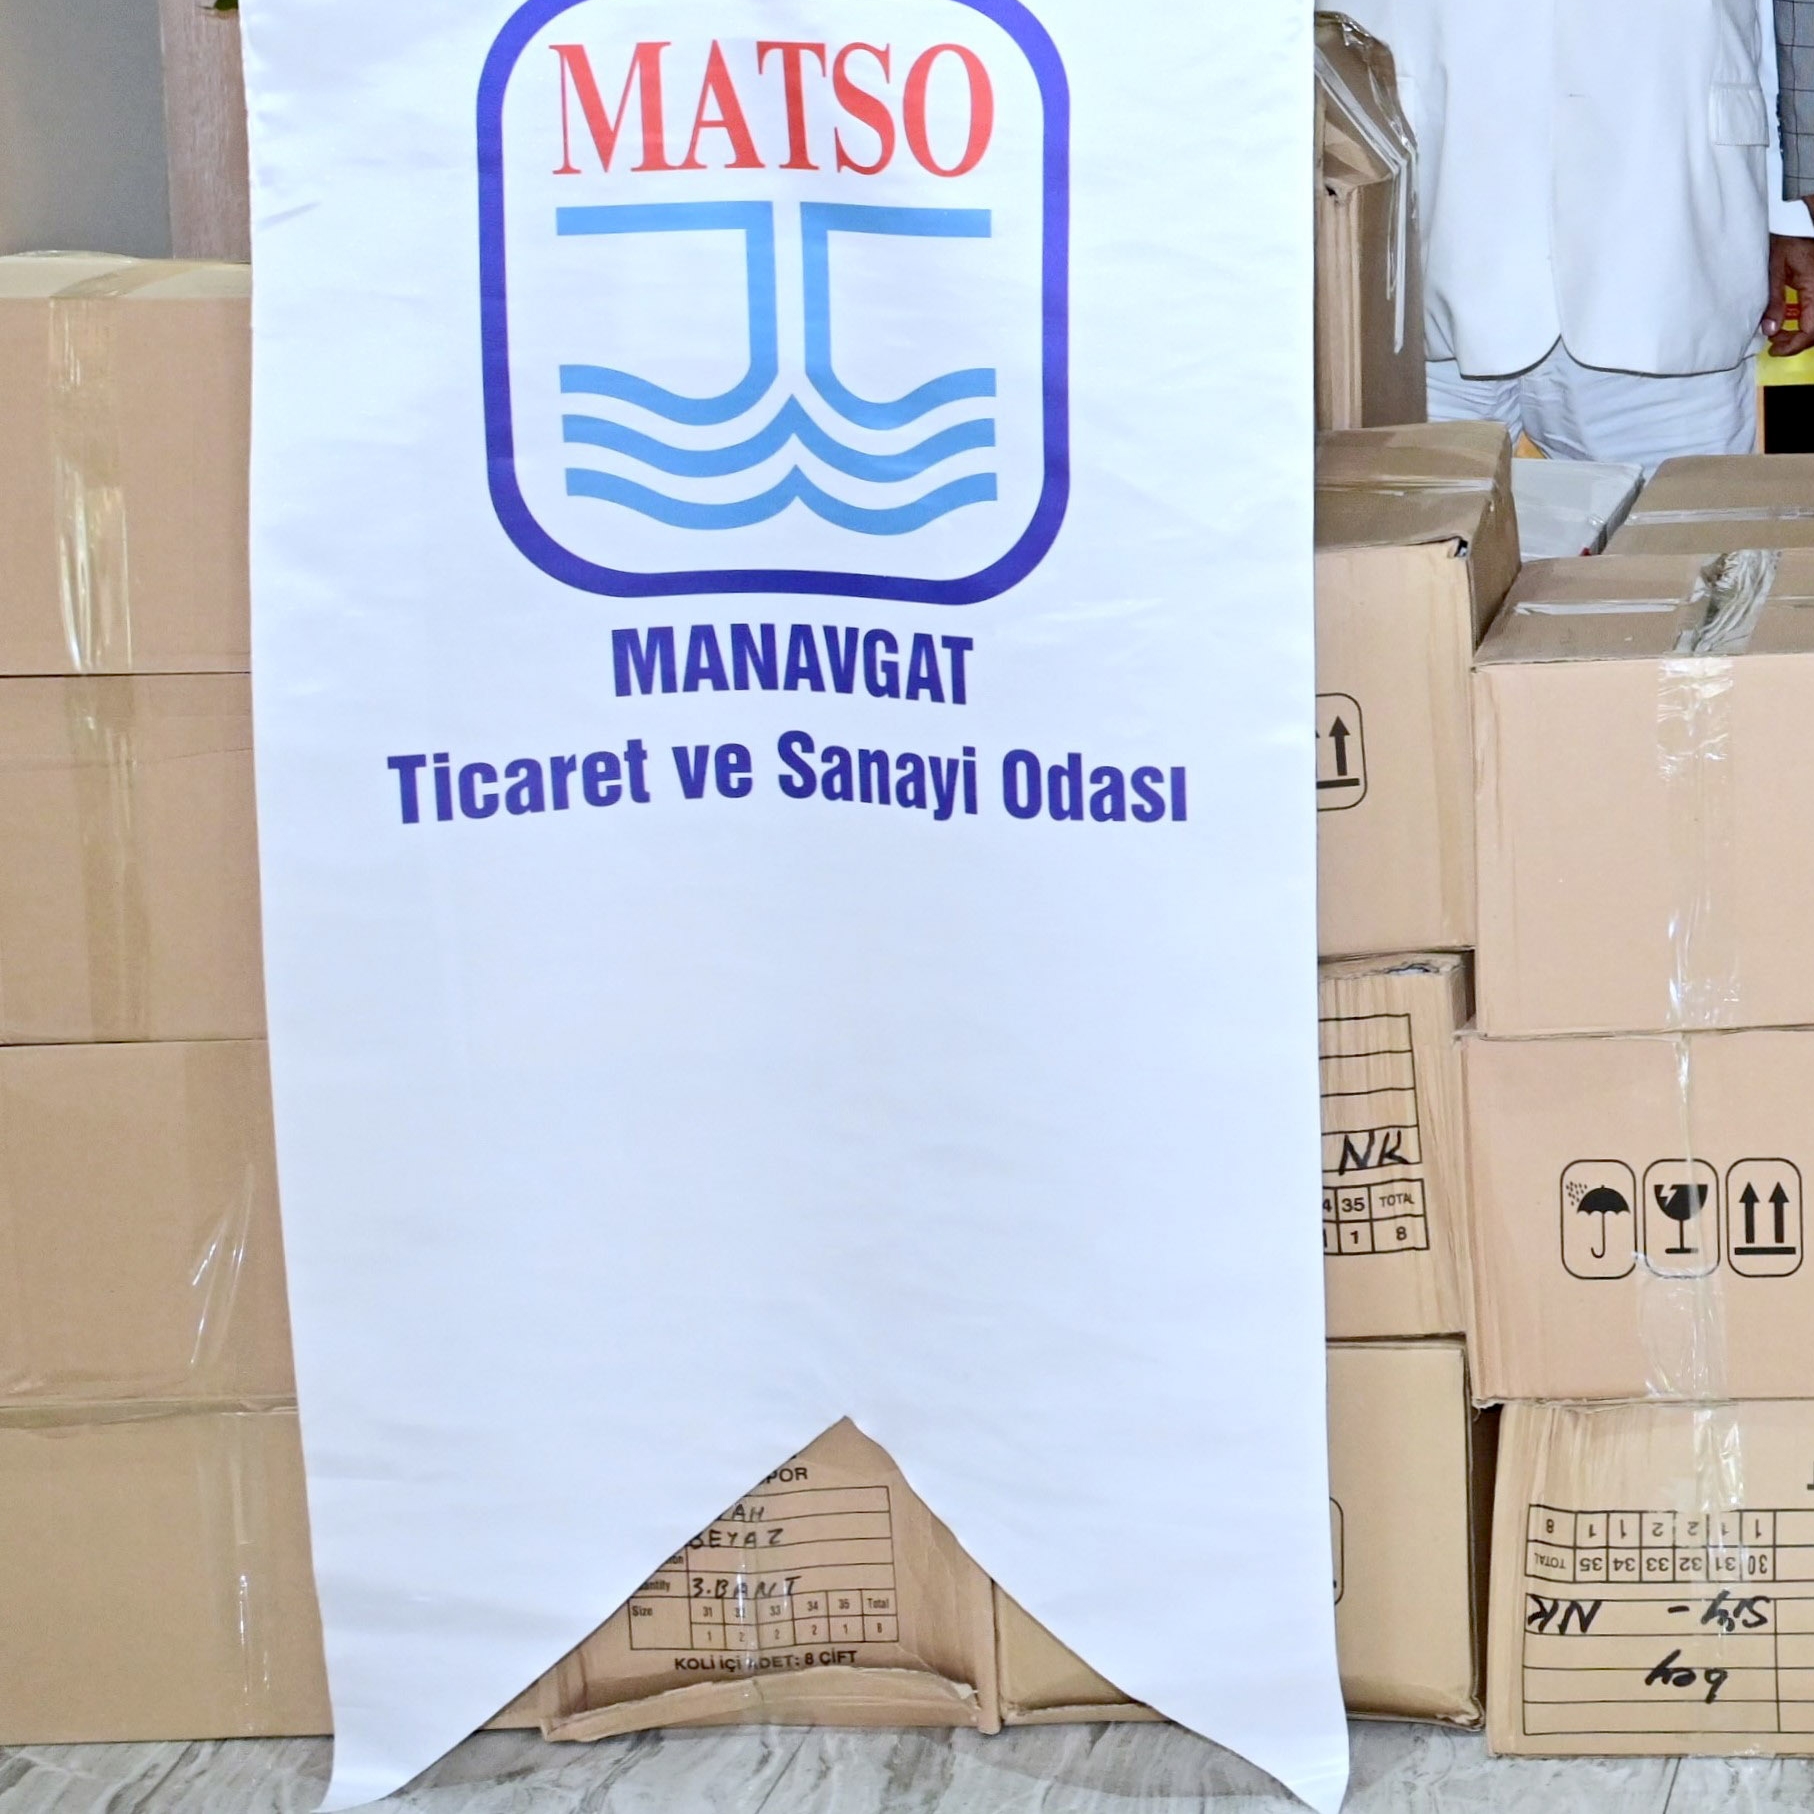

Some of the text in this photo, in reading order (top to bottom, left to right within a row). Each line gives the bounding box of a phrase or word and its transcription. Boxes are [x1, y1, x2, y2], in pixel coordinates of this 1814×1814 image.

[548, 39, 995, 179] MATSO
[611, 622, 975, 706] MANAVGAT
[387, 729, 1189, 826] Ticaret ve Sanayi Odası
[1341, 1197, 1365, 1212] 35
[1379, 1192, 1415, 1208] TOTAL
[1351, 1226, 1407, 1244] 1 8
[1545, 1518, 1763, 1539] 1 2 2 1 1 8
[1534, 1552, 1565, 1569] TOTAL
[1579, 1557, 1603, 1573] 35
[1613, 1557, 1635, 1572] 34
[1646, 1557, 1669, 1572] 33
[1679, 1557, 1703, 1572] 32
[1715, 1557, 1736, 1572] 31
[1747, 1554, 1768, 1574] 30
[632, 1597, 890, 1617] Size 31 33 34 35 Total
[774, 1629, 780, 1640] 2
[811, 1626, 818, 1636] 2
[843, 1623, 848, 1634] 1
[675, 1656, 716, 1671] KOLİ
[804, 1652, 814, 1665] 8
